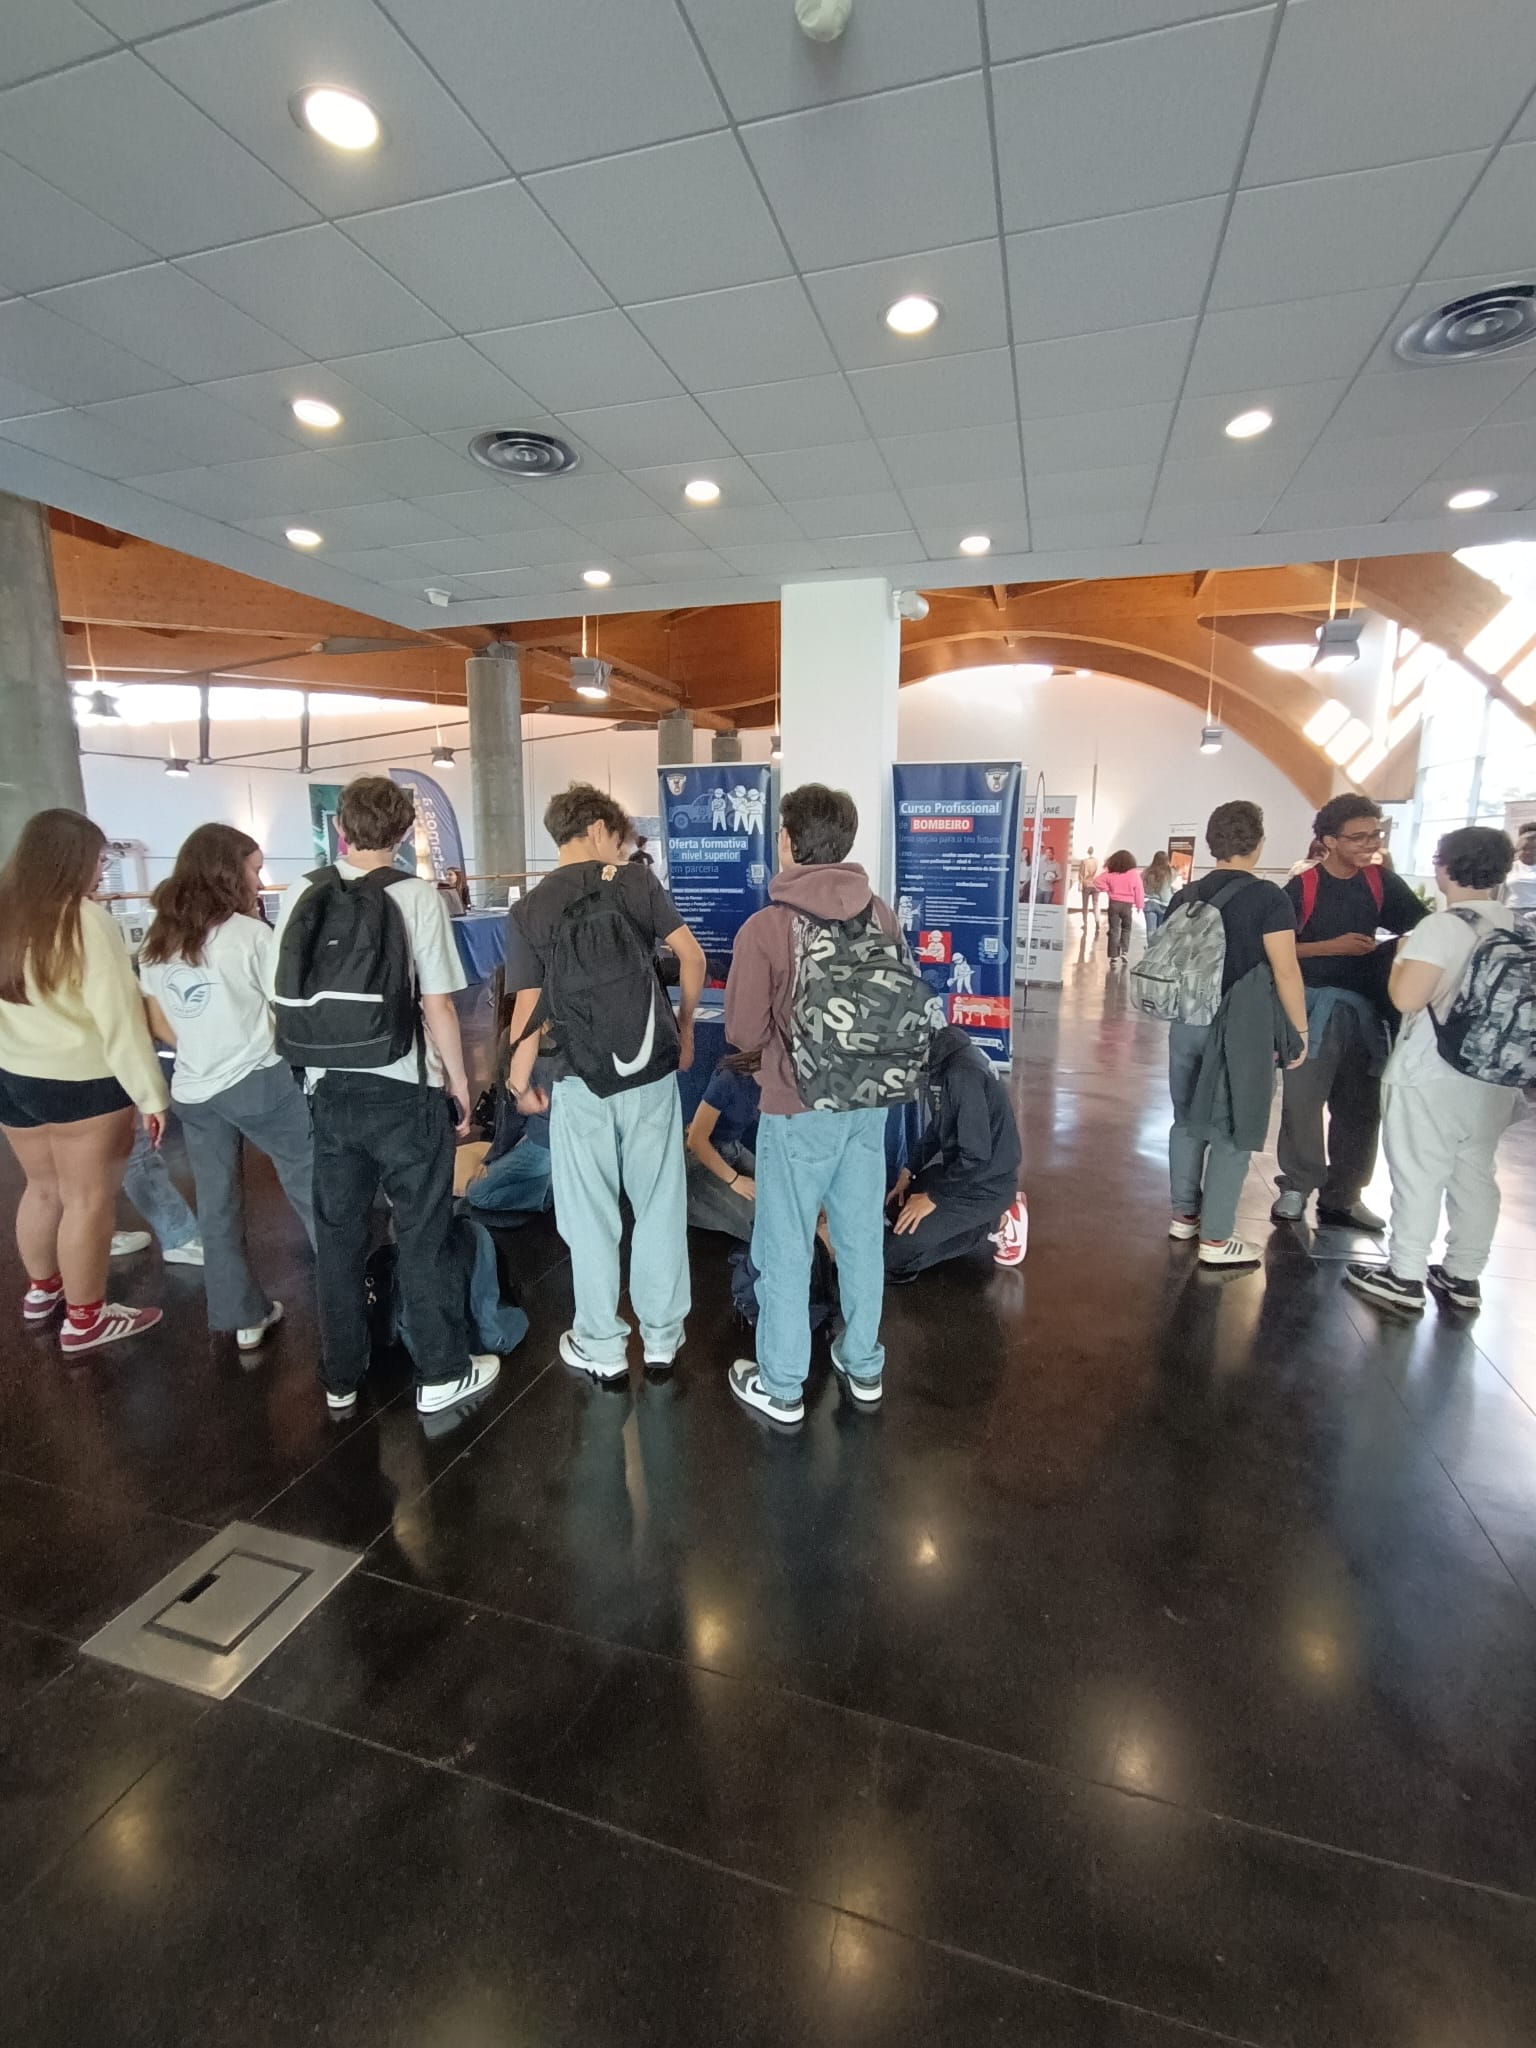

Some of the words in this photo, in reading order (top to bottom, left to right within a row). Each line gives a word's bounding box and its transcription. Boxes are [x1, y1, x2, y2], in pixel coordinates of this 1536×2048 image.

[900, 802, 931, 814] Curso
[934, 801, 1000, 814] Profissional
[913, 819, 970, 830] BOMBEIRO
[668, 839, 699, 849] Oferta
[701, 837, 747, 849] formativa
[704, 850, 739, 863] superior
[684, 864, 719, 876] parceria
